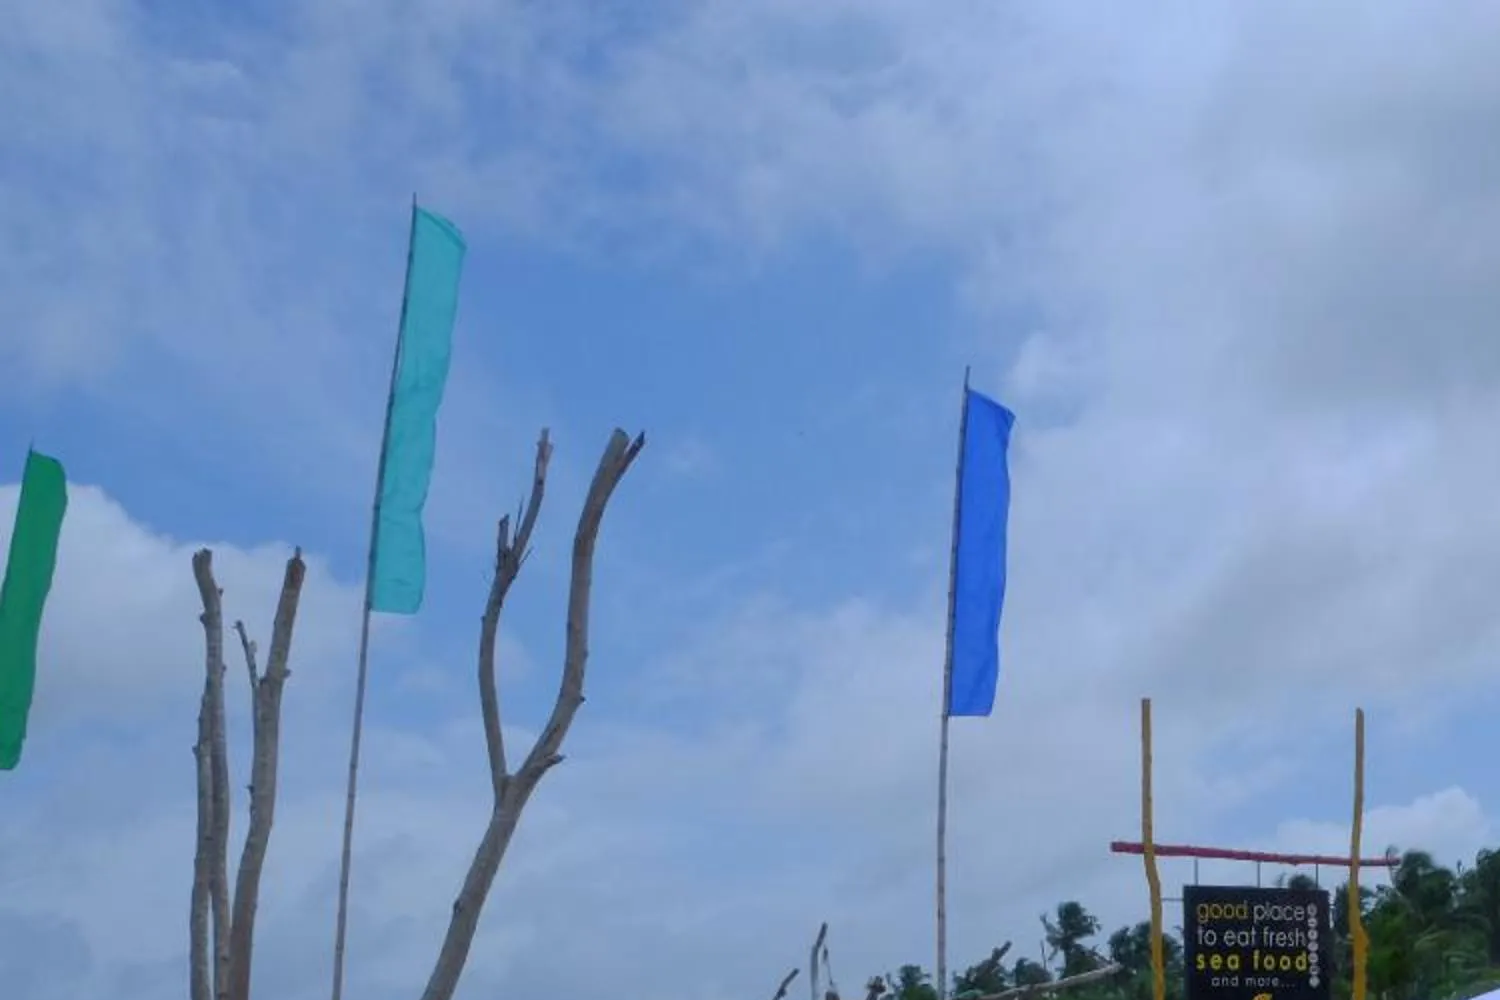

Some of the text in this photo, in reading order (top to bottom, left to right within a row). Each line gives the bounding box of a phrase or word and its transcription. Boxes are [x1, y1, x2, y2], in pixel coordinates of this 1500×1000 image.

[1196, 900, 1305, 923] good place
[1197, 926, 1306, 947] to eat fresh
[1196, 949, 1307, 970] sea food
[1211, 975, 1239, 987] and
